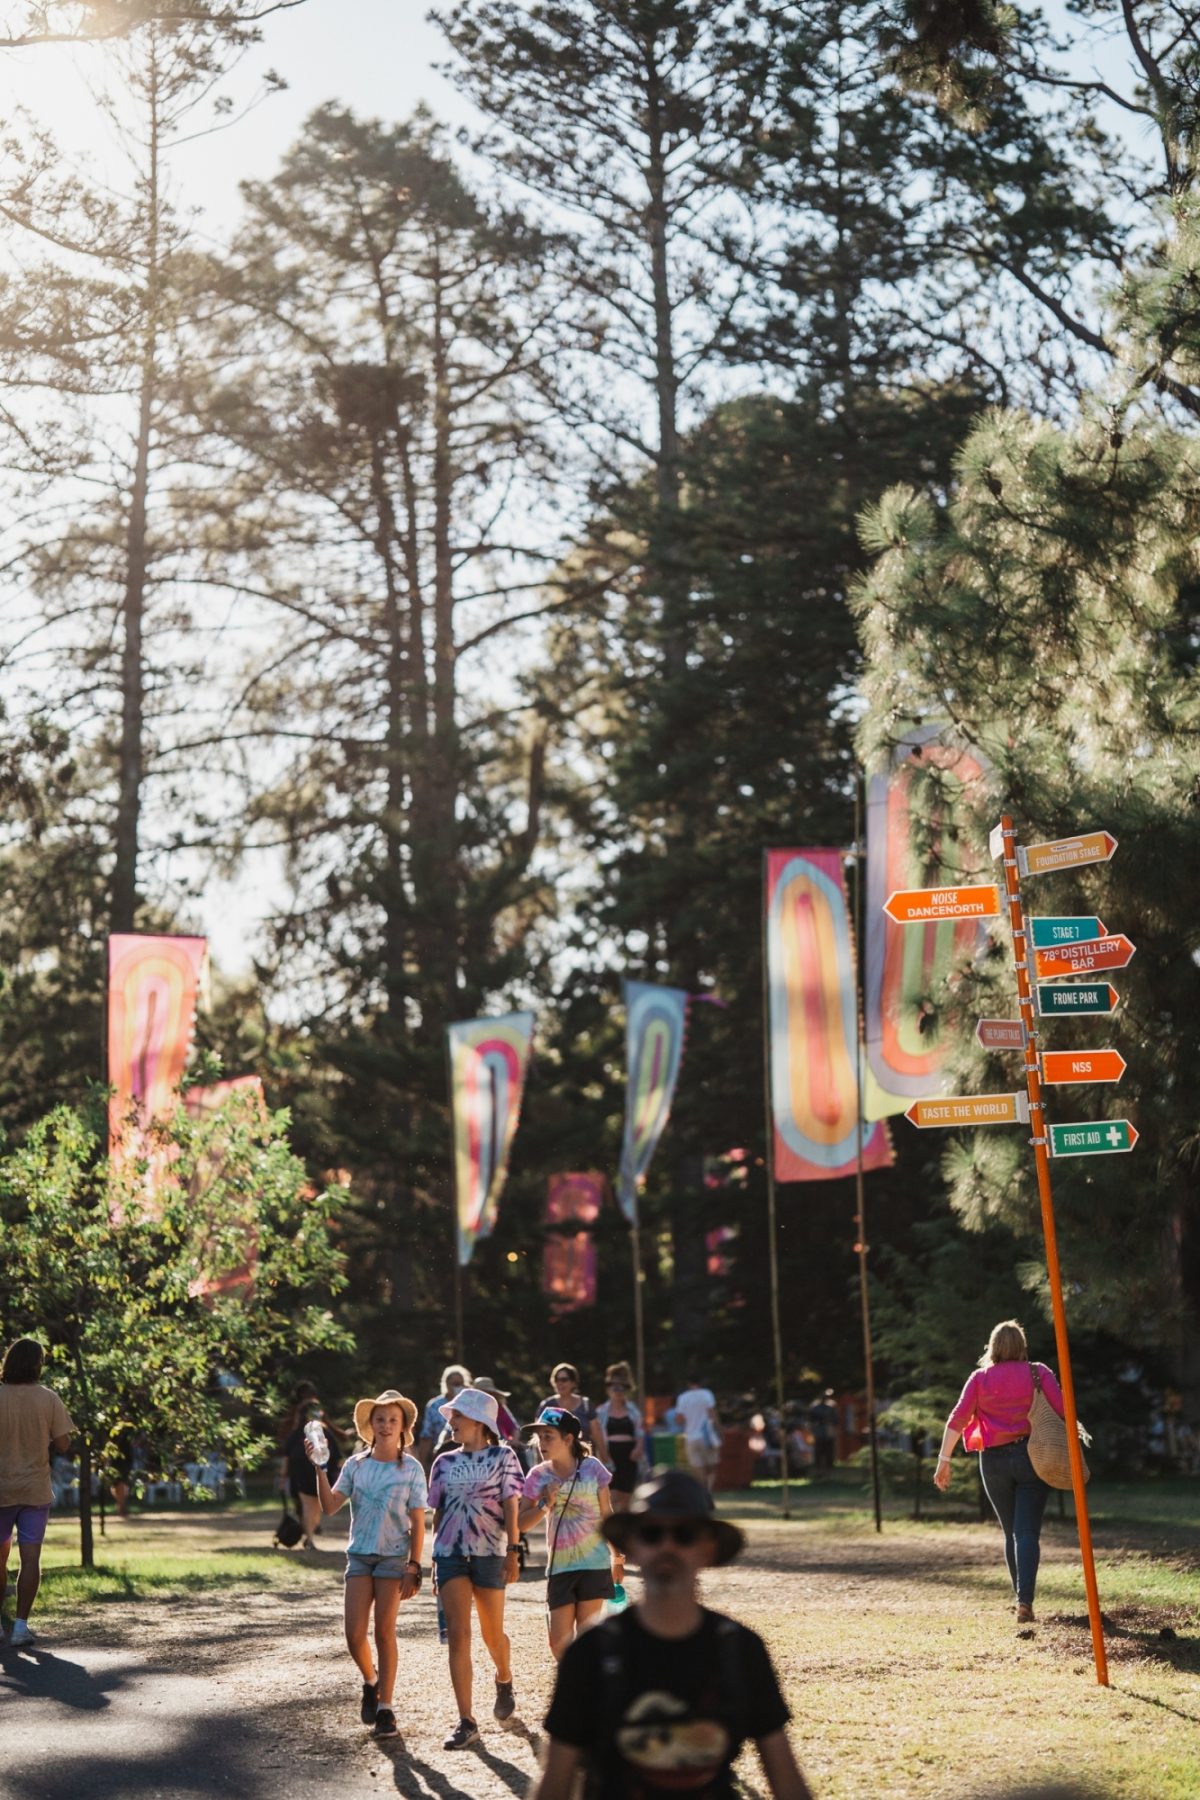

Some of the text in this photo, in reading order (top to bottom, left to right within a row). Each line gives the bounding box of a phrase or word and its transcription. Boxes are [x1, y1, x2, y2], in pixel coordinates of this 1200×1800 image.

[1036, 852, 1078, 868] FOUNDATION
[1080, 846, 1101, 857] STAGE
[931, 892, 959, 905] NOISE
[907, 903, 985, 917] DANCENORTH
[1052, 926, 1074, 939] STAGE
[1043, 940, 1121, 963] 78° DISTILLERY
[1071, 957, 1095, 970] BAR
[1053, 991, 1099, 1005] FROME PARK
[1072, 1061, 1092, 1073] NSS
[922, 1103, 1008, 1119] TASTE THE WORLD
[1063, 1131, 1101, 1147] FIRST AID
